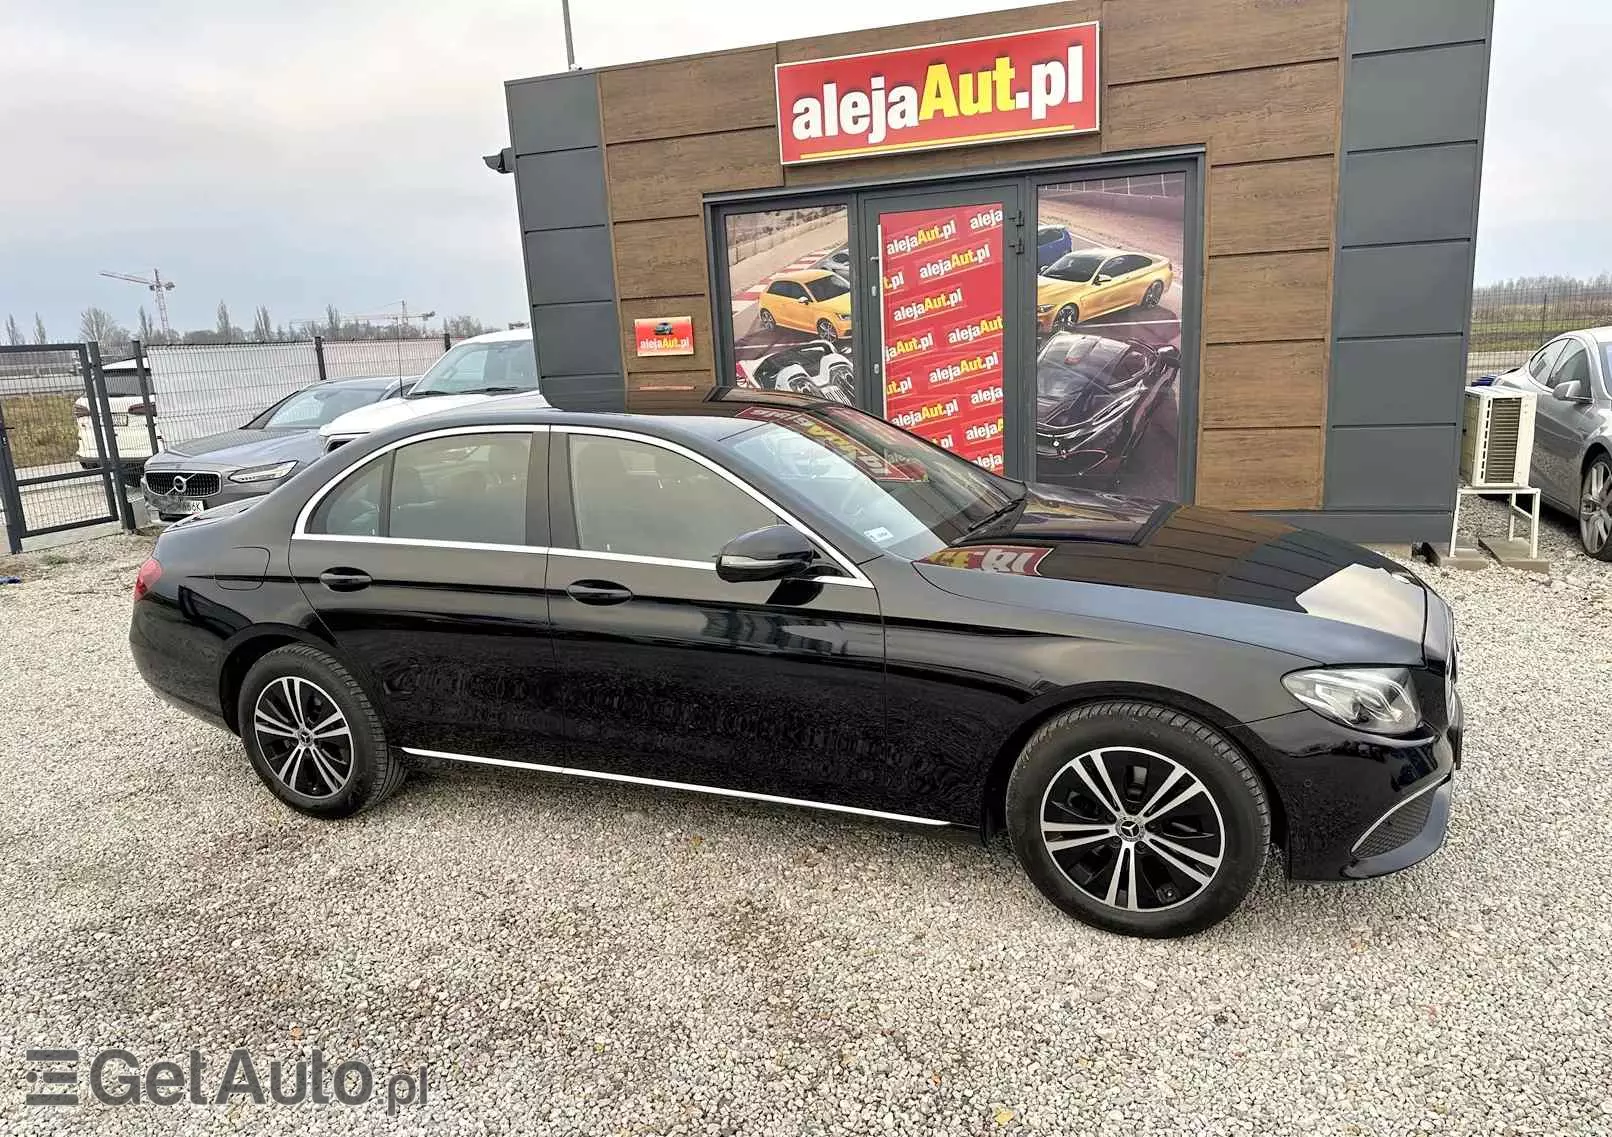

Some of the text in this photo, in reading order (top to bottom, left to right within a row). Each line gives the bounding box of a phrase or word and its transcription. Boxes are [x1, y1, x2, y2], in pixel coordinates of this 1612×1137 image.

[792, 45, 1083, 144] alejaAut.pl
[886, 220, 956, 255] alejaAut.pl
[919, 244, 990, 279] alejaAut.pl
[893, 288, 962, 321] alejaAut.pl
[929, 352, 998, 383] alejaAut.pl
[892, 399, 959, 427] alejaAut.pl
